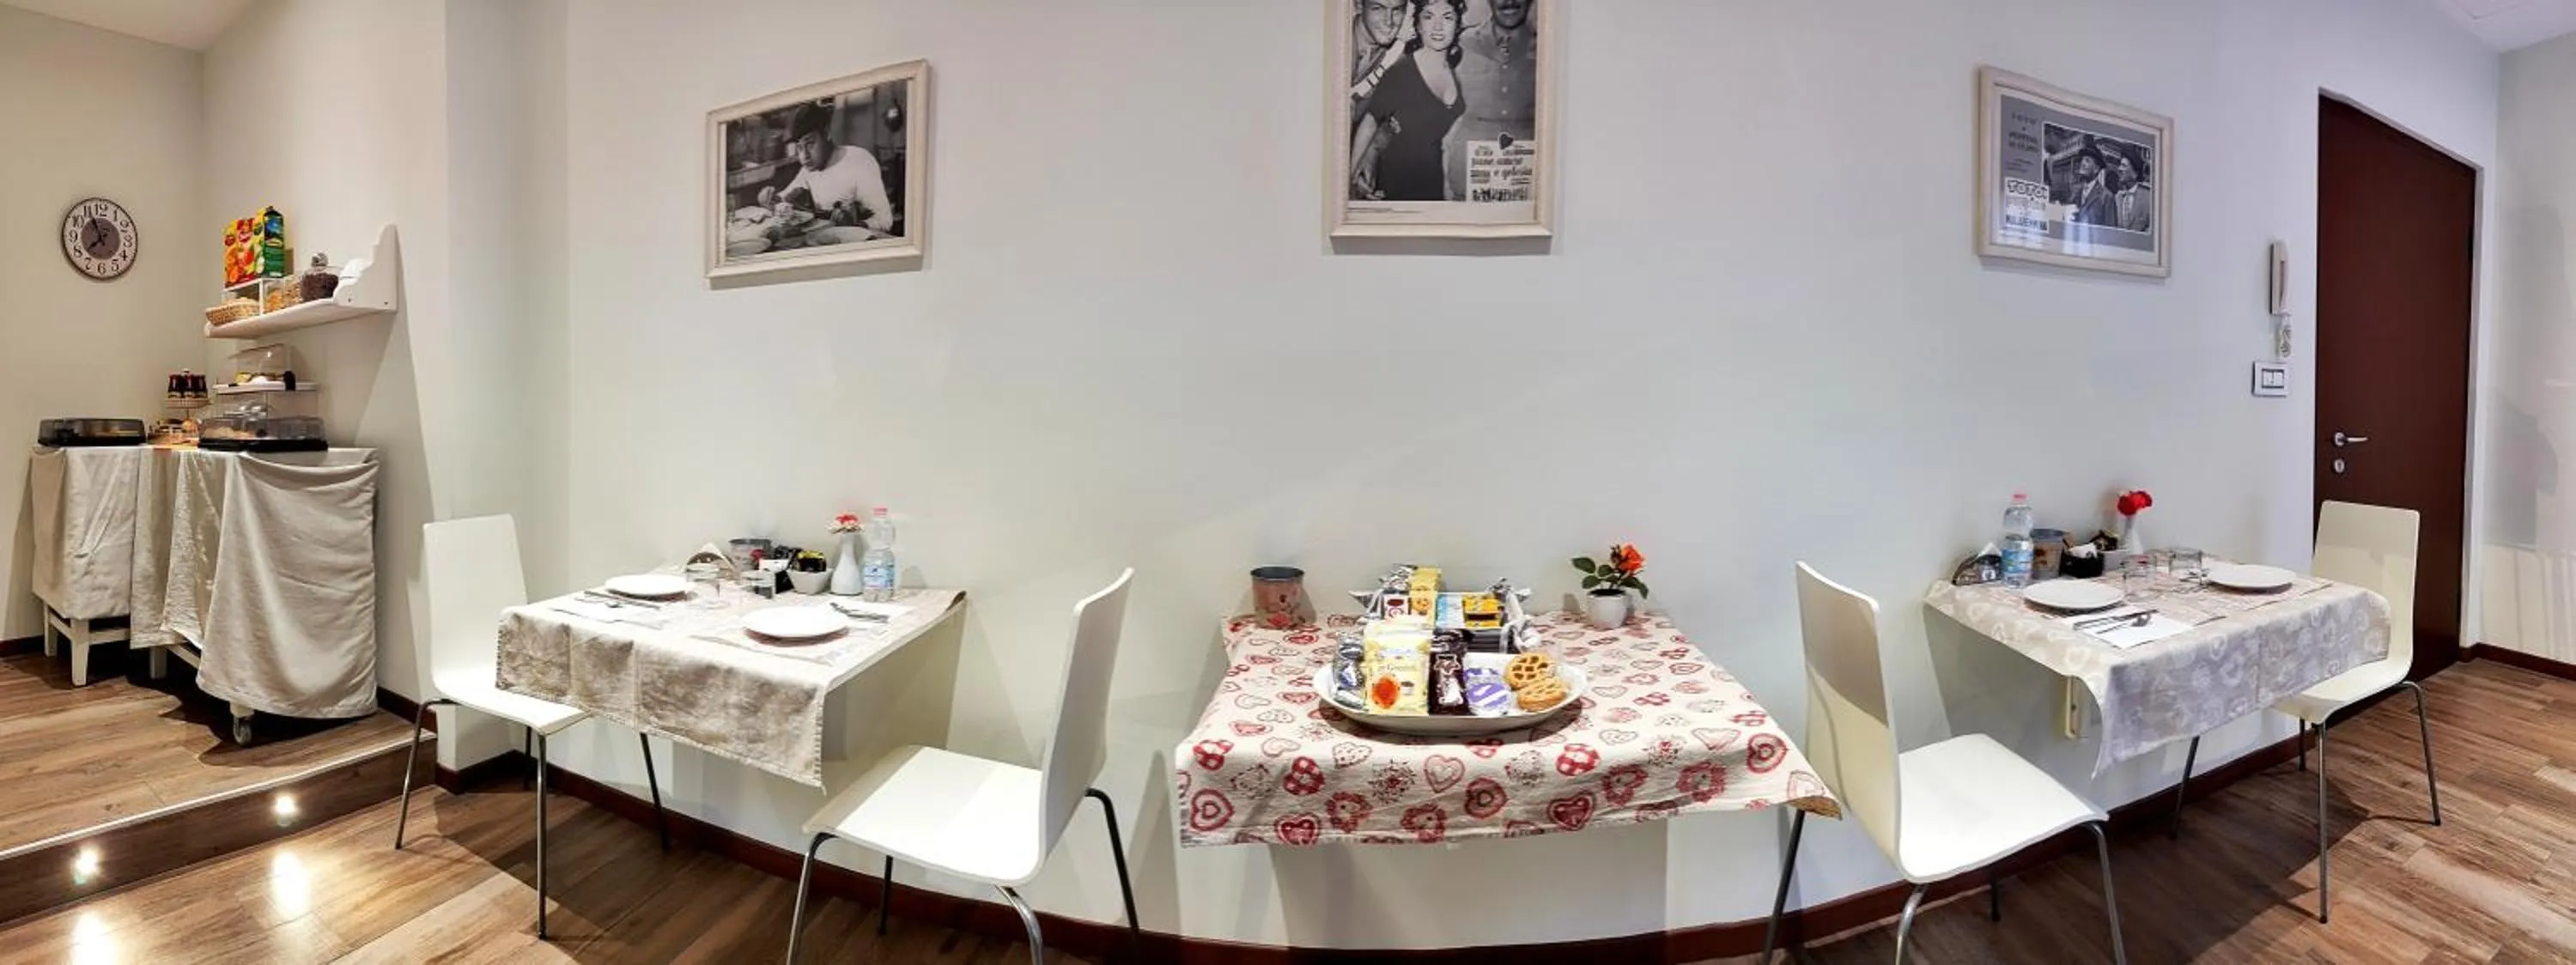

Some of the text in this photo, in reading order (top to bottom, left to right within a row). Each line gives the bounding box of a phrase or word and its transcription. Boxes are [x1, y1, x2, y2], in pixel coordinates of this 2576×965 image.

[94, 202, 108, 217] 12
[97, 262, 107, 276] 6
[111, 258, 120, 273] 5
